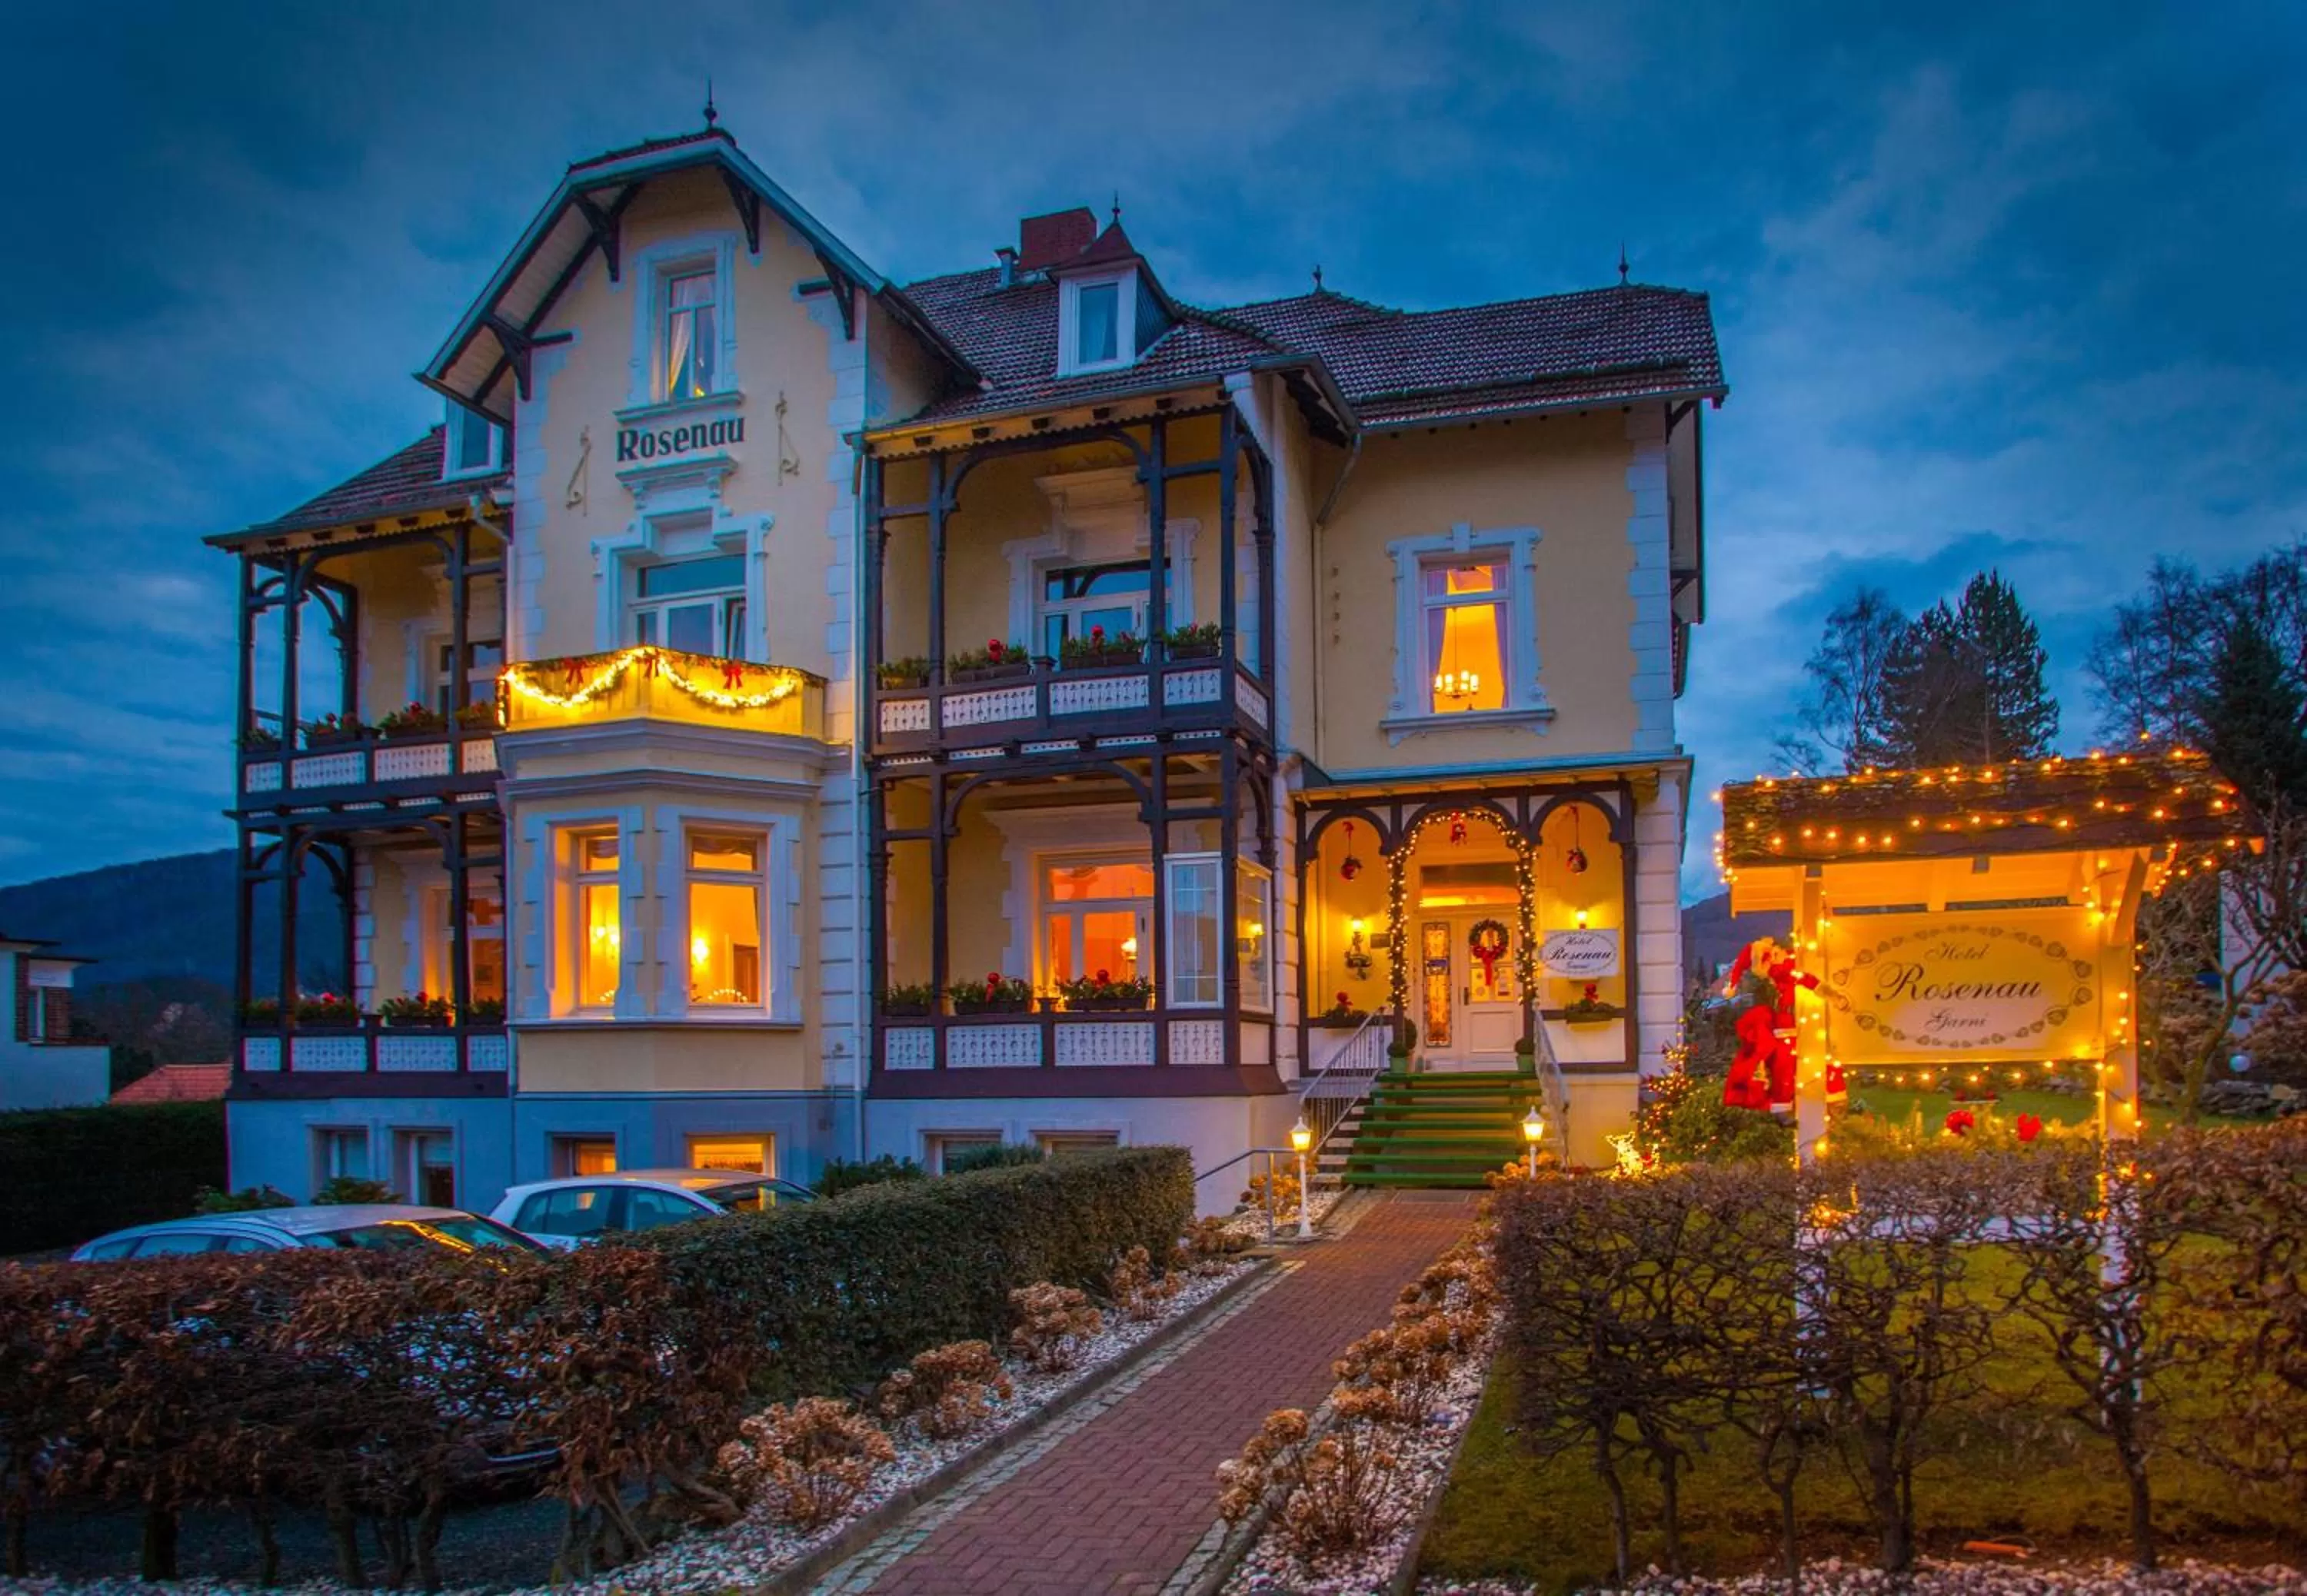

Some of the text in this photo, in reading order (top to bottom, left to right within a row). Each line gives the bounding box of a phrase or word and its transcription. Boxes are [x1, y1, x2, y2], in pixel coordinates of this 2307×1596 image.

[618, 417, 745, 462] Rosenau
[1549, 946, 1612, 960] Rosenau
[1924, 942, 1990, 961] Hotel
[1874, 961, 2042, 1002] Rosenau
[1925, 1006, 1988, 1032] Garni
